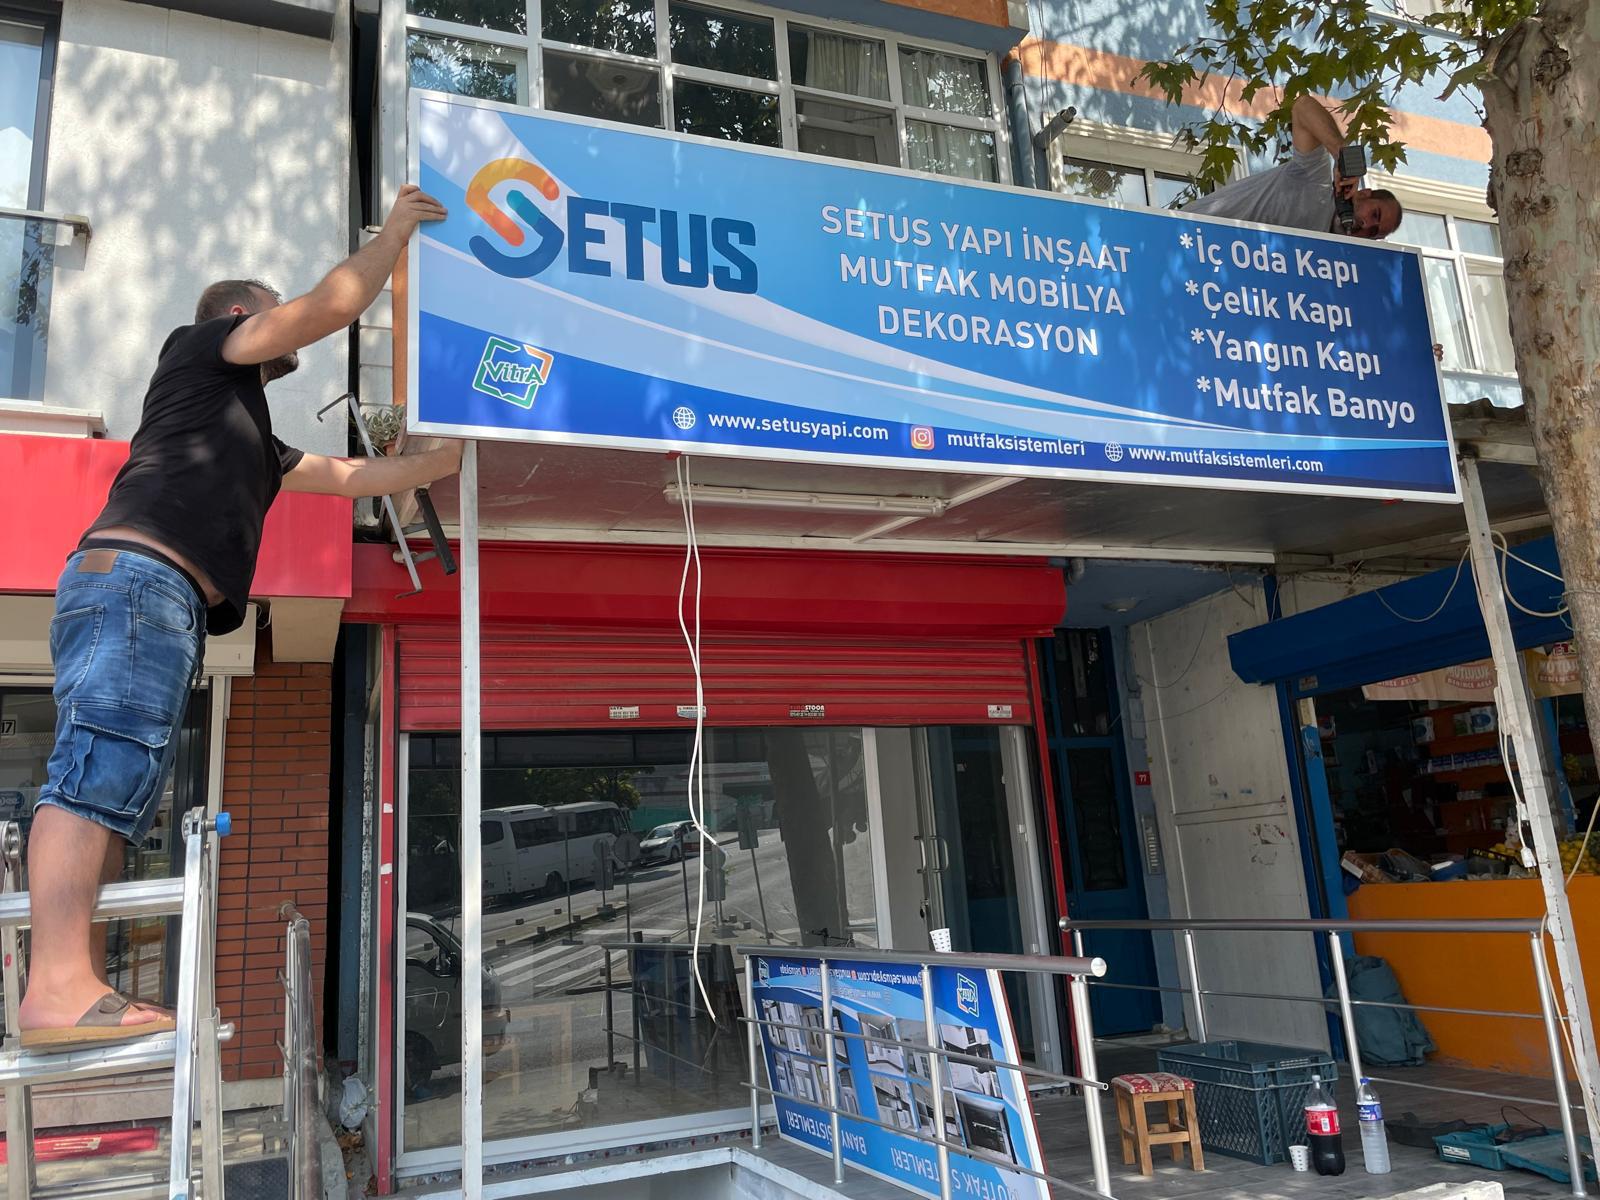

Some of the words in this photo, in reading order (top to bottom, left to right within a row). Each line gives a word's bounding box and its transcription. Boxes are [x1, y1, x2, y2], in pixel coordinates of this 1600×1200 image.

[465, 157, 758, 294] SETUS
[821, 205, 932, 247] SETUS
[940, 222, 1012, 258] YAPI
[1022, 227, 1131, 273] İNŞAAT
[840, 253, 980, 298] MUTFAK
[990, 272, 1126, 316] MOBİLYA
[1231, 240, 1288, 275] Oda
[1296, 248, 1359, 288] Kapı
[878, 304, 1098, 356] DEKORASYON
[1287, 292, 1353, 332] Kapı
[483, 360, 546, 385] VitrA
[1316, 341, 1381, 381] Kapı
[708, 413, 889, 441] www.setusyapi.com
[1327, 387, 1415, 429] Banyo
[947, 432, 1086, 456] mutfaksistemleri
[1128, 446, 1324, 473] www.mutfaksistemleri.com
